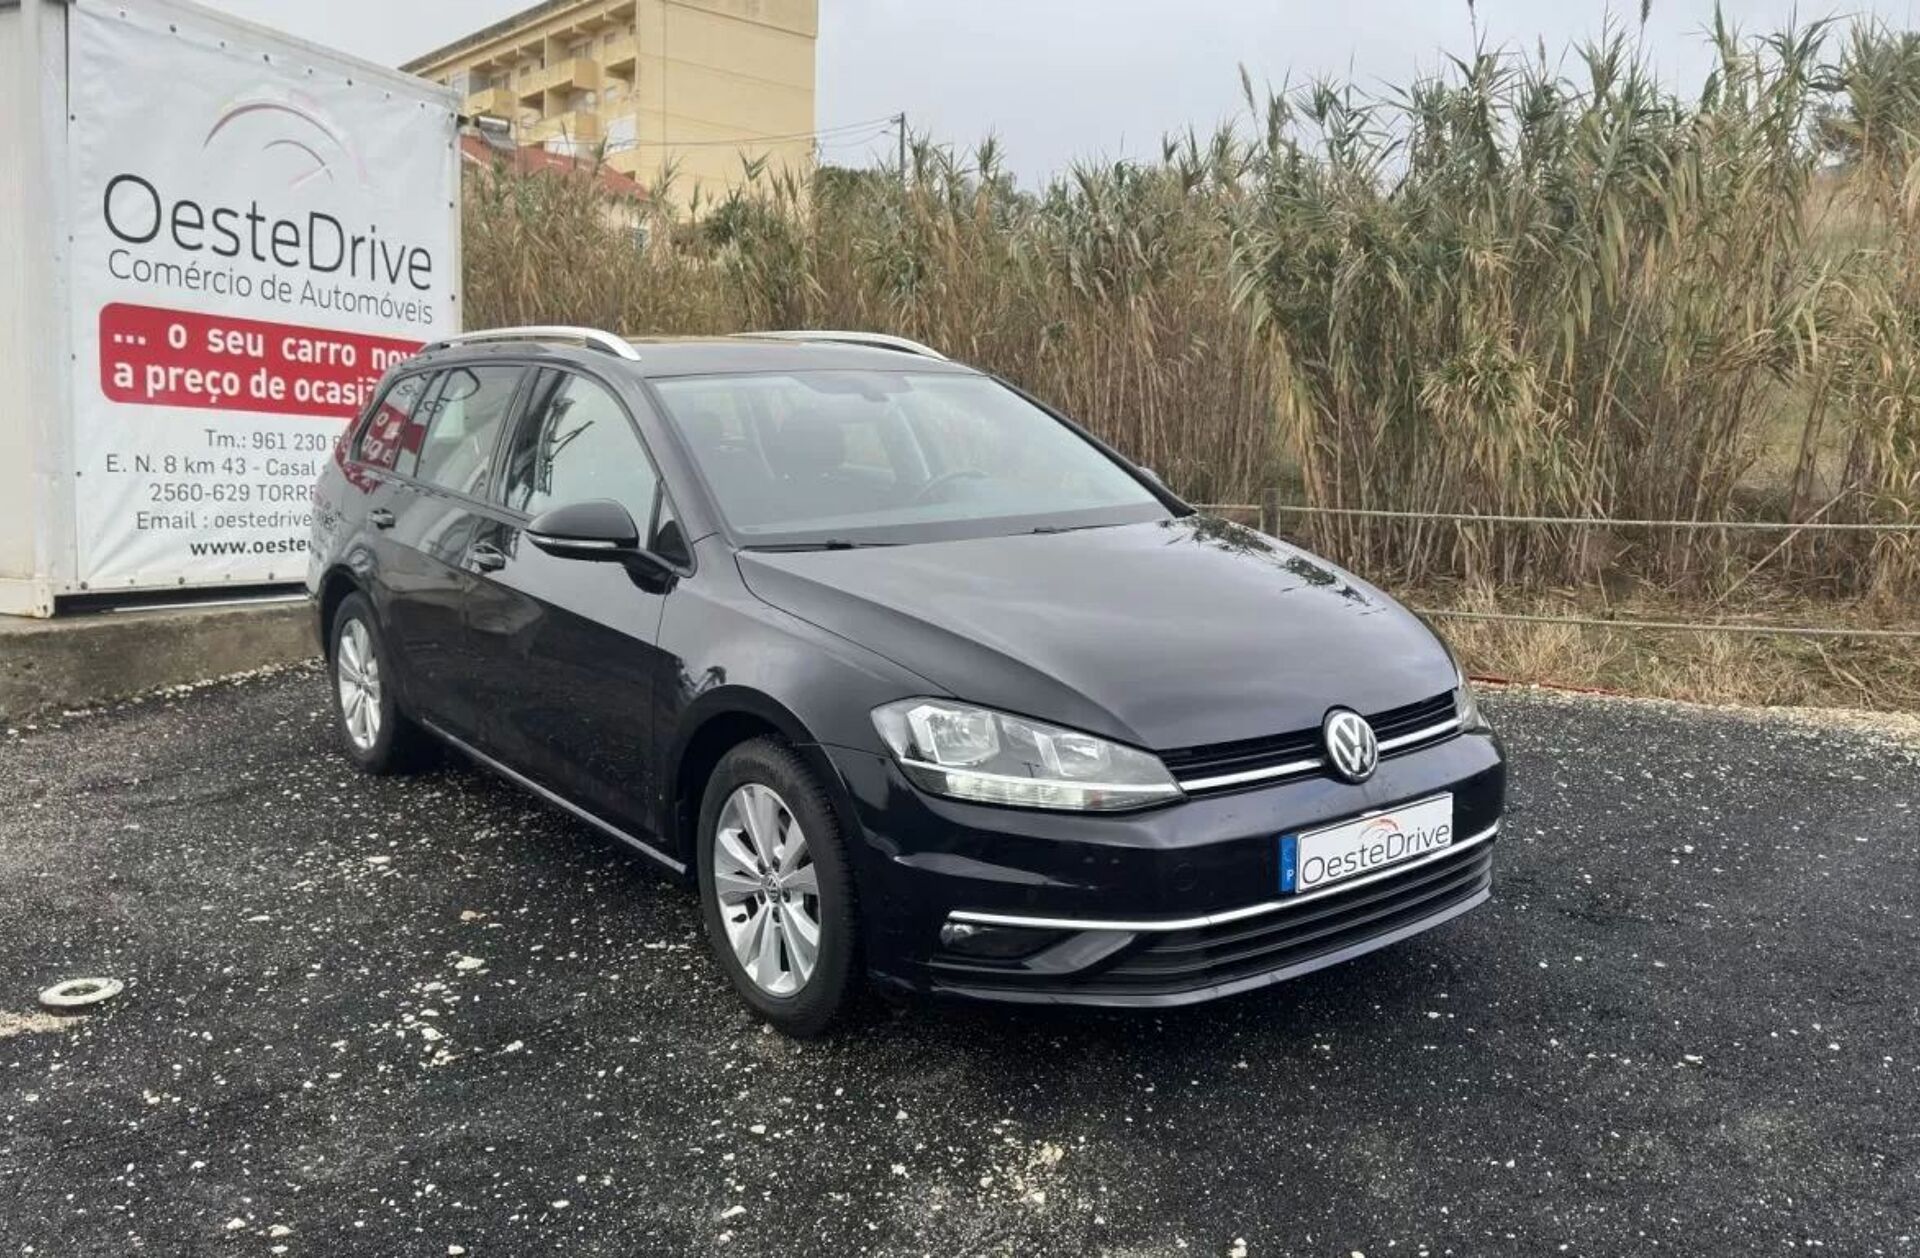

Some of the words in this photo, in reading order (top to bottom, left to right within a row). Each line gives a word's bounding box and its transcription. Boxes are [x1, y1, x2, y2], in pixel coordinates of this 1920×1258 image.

[104, 173, 432, 291] OesteDrive
[108, 248, 252, 297] Comércio
[261, 275, 292, 303] de
[300, 279, 433, 325] Automóveis
[168, 323, 187, 350] o
[207, 328, 264, 357] seu
[282, 337, 356, 367] carro
[113, 362, 133, 388] a
[146, 364, 240, 404] preço
[250, 367, 286, 400] de
[204, 429, 246, 449] Tm.:
[252, 432, 287, 450] 961
[294, 433, 327, 452] 230
[106, 453, 127, 473] E.
[135, 454, 157, 474] N.
[164, 454, 177, 474] 8
[184, 457, 216, 474] km
[221, 457, 247, 476] 43
[265, 458, 317, 477] Casal
[149, 482, 250, 502] 2560-629
[136, 510, 197, 530] Email
[190, 536, 313, 556] www.oeste
[1302, 823, 1450, 884] OesteDrive
